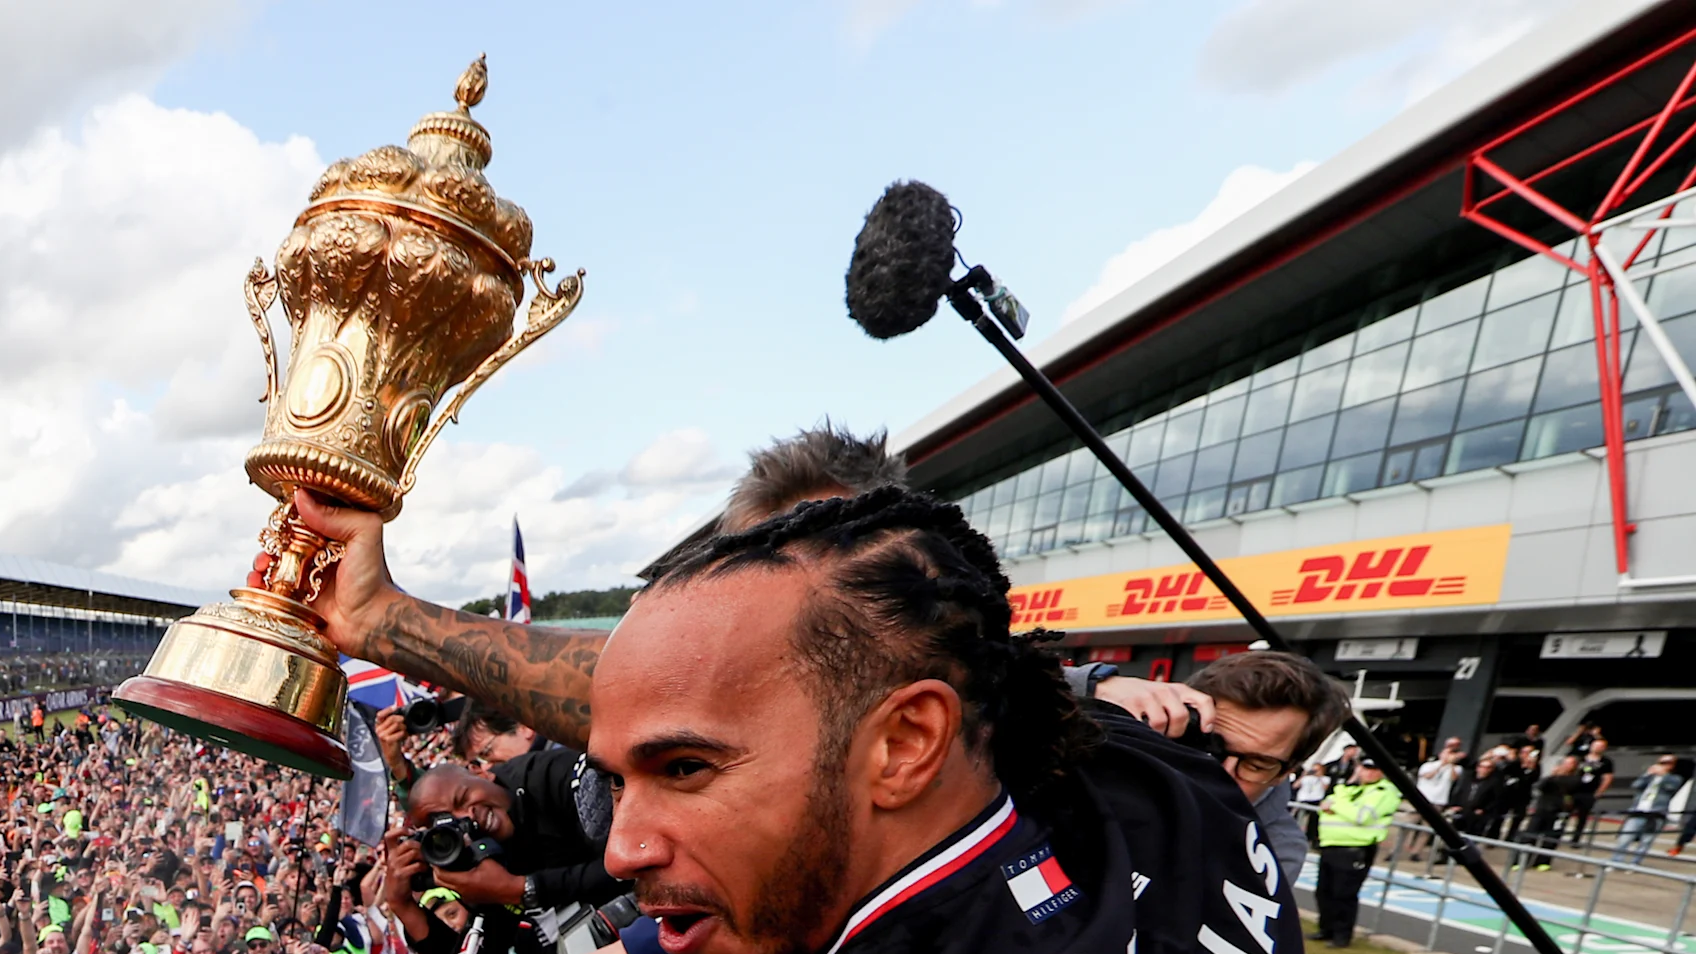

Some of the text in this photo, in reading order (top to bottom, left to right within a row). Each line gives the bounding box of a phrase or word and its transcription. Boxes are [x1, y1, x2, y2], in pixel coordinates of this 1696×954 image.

[1291, 544, 1433, 604] DHL
[1010, 588, 1065, 625] DHL
[1121, 571, 1211, 616] DHL
[1454, 656, 1481, 681] 27
[1007, 846, 1051, 874] TOMMY
[1031, 888, 1079, 919] HILFIGER
